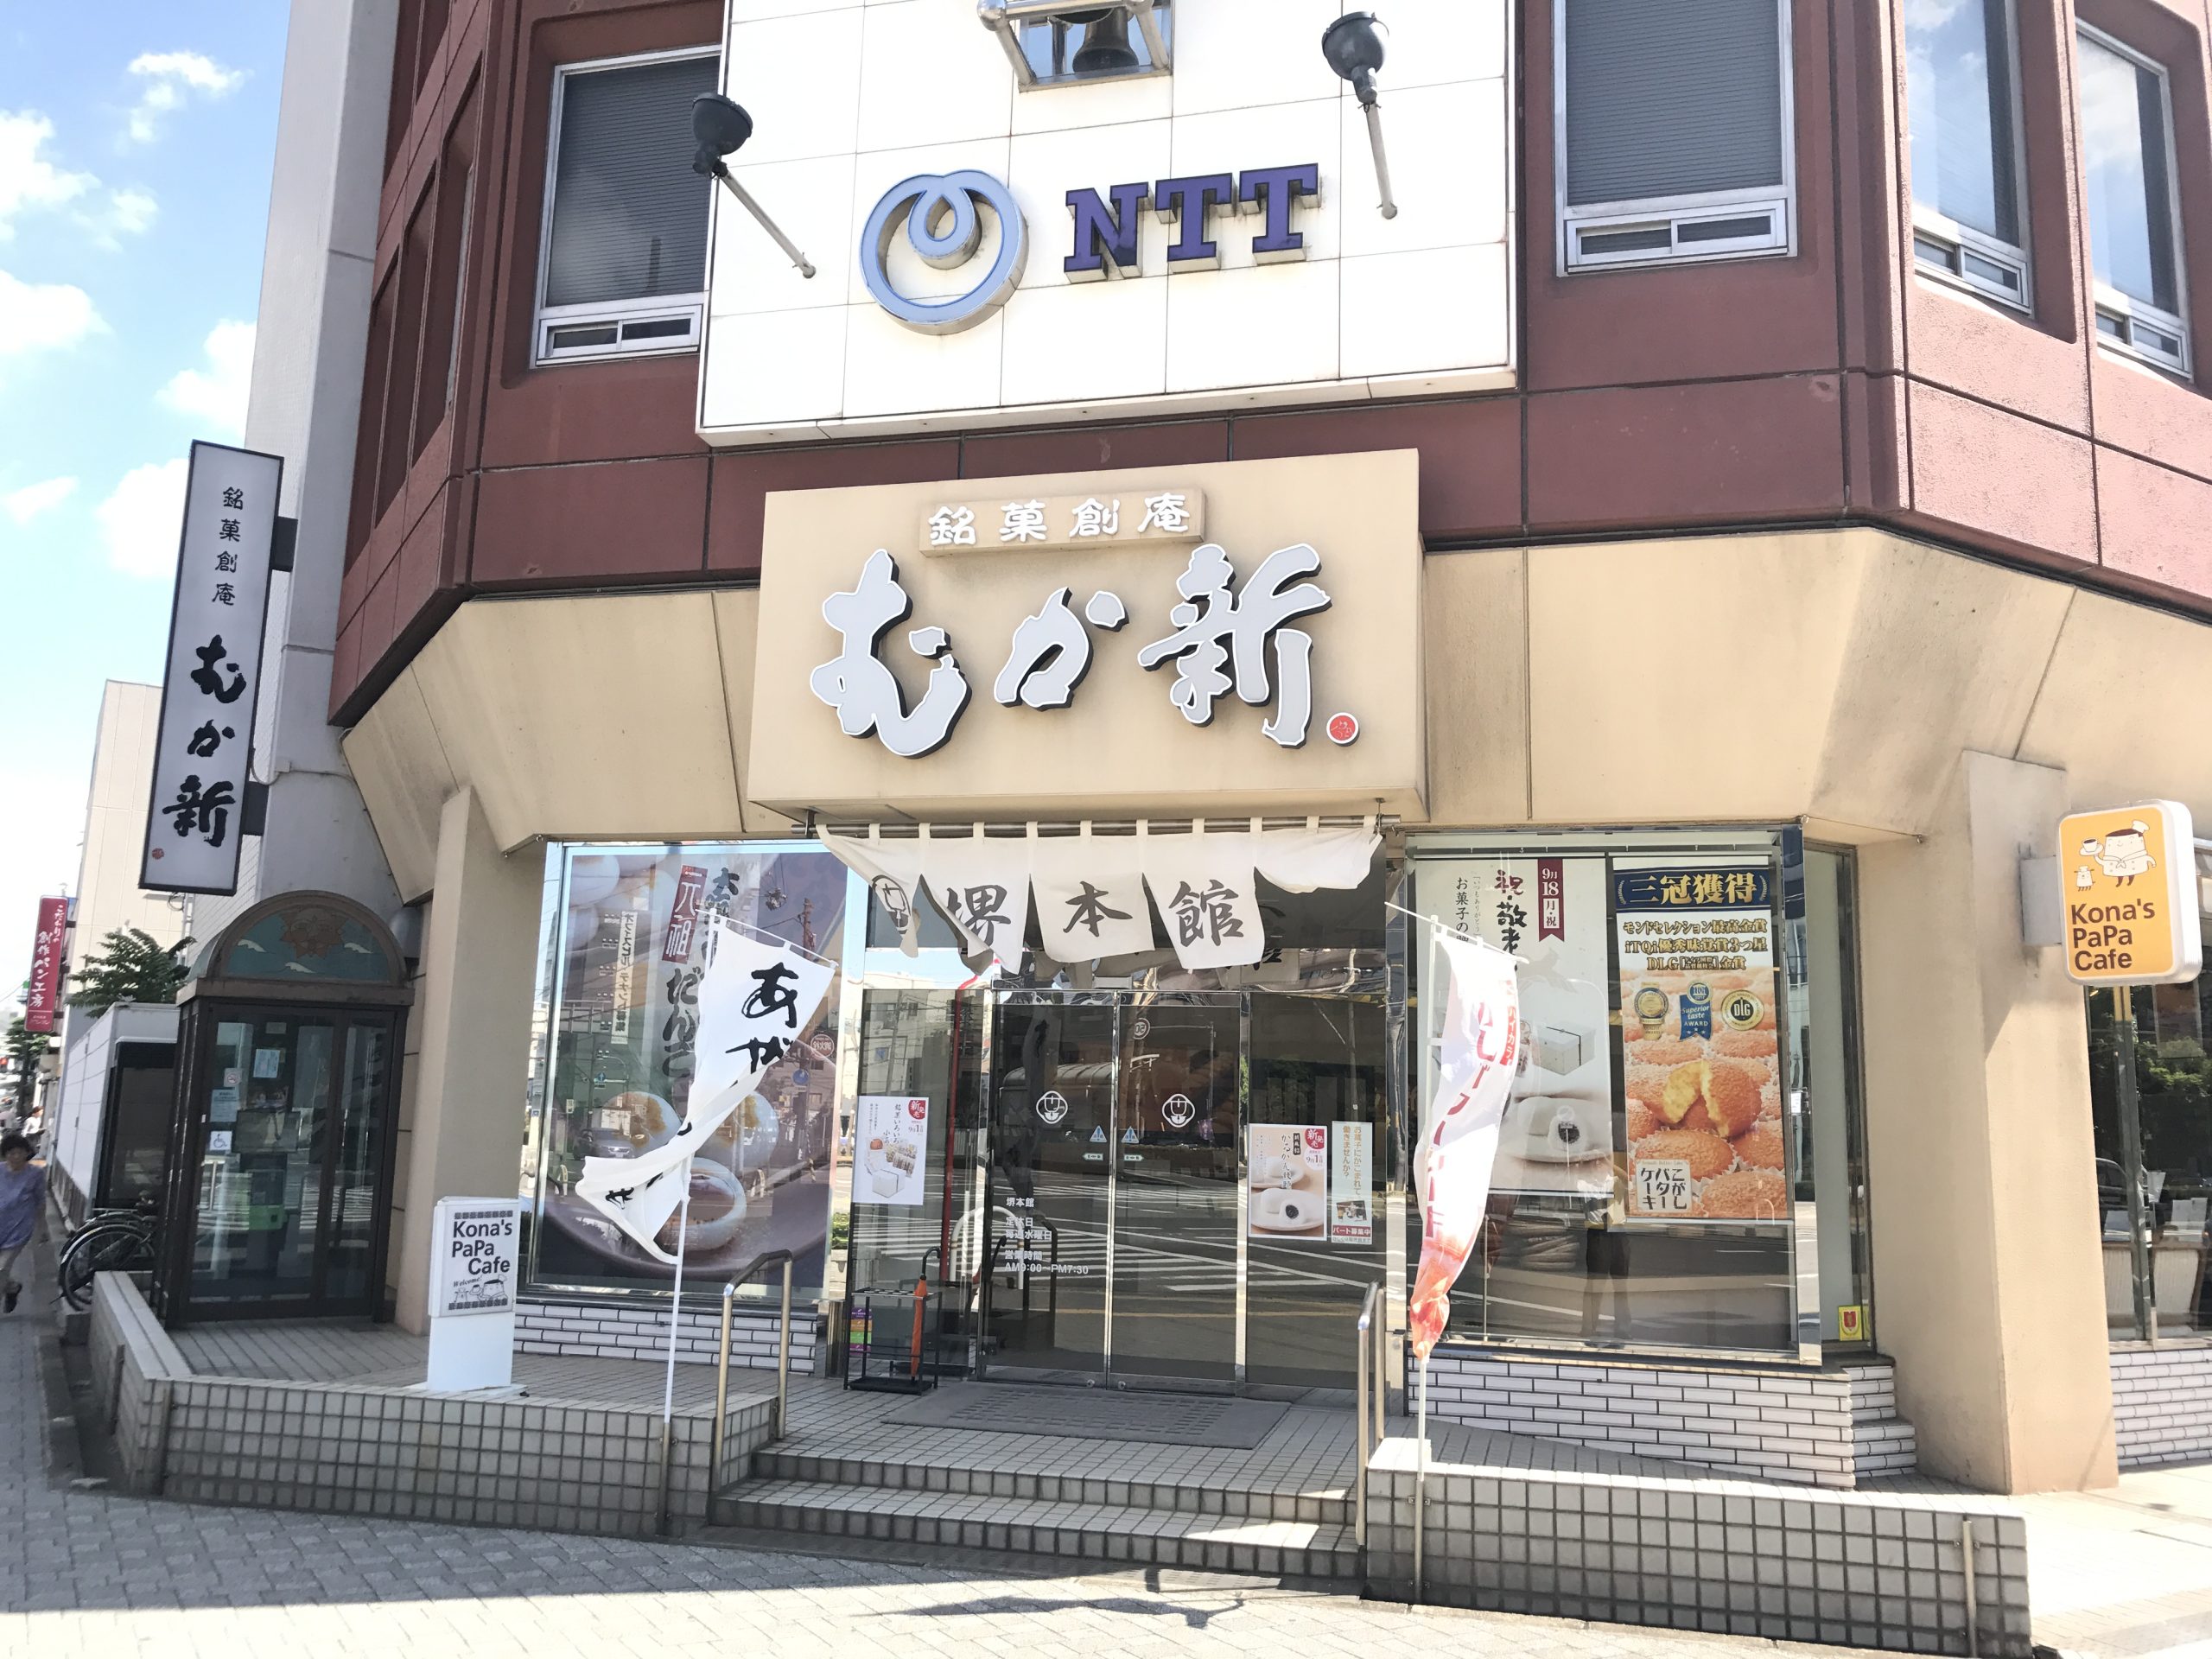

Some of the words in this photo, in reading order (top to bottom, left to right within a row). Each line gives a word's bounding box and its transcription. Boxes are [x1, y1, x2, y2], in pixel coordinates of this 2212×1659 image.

[1064, 162, 1320, 278] NTT
[928, 493, 1191, 546] 銘菓創庵
[810, 543, 1333, 759] むか新
[162, 633, 247, 848] むか新
[1541, 881, 1560, 896] 18
[1630, 872, 1758, 905] 三冠獲得
[1455, 877, 1470, 942] お菓子の
[2071, 899, 2155, 925] Kona's
[1623, 918, 1768, 935] モンドセレクション最高金賞
[2073, 925, 2133, 949] PaPa
[2075, 949, 2133, 971] Cafe
[1006, 1197, 1035, 1208] 堺本館
[453, 1218, 513, 1238] Kona's
[1332, 1227, 1371, 1236] パート募集中
[451, 1239, 495, 1258] PaPa
[467, 1255, 512, 1275] Cafe
